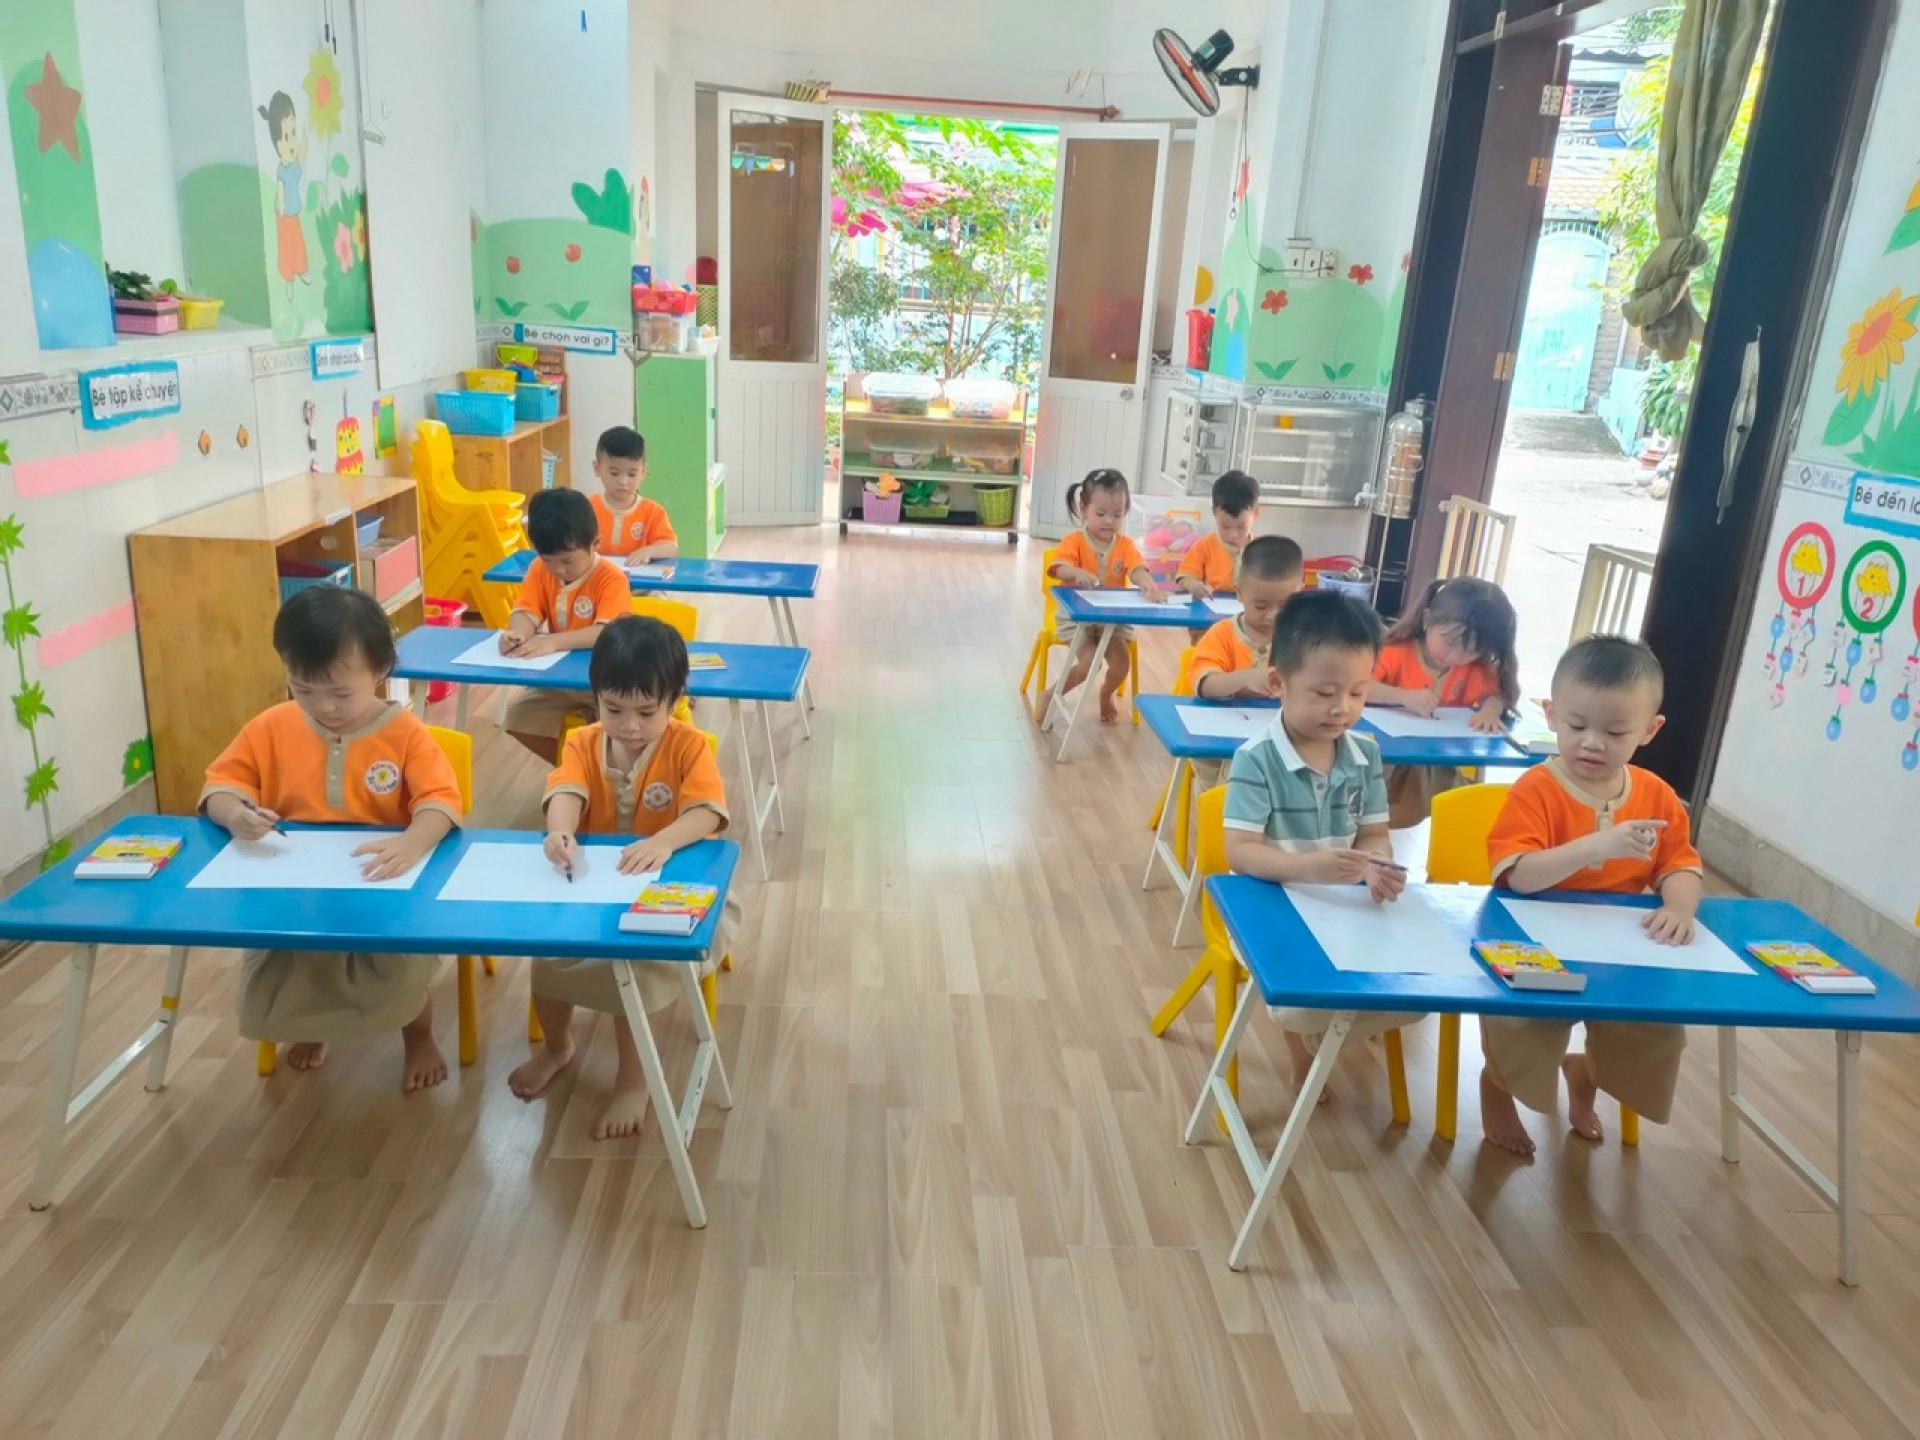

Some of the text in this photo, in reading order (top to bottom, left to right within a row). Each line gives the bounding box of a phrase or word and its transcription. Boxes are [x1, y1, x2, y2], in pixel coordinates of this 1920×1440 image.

[1854, 485, 1873, 505] Bé
[1877, 490, 1906, 512] đến
[1797, 576, 1806, 596] 1
[1860, 597, 1875, 620] 2
